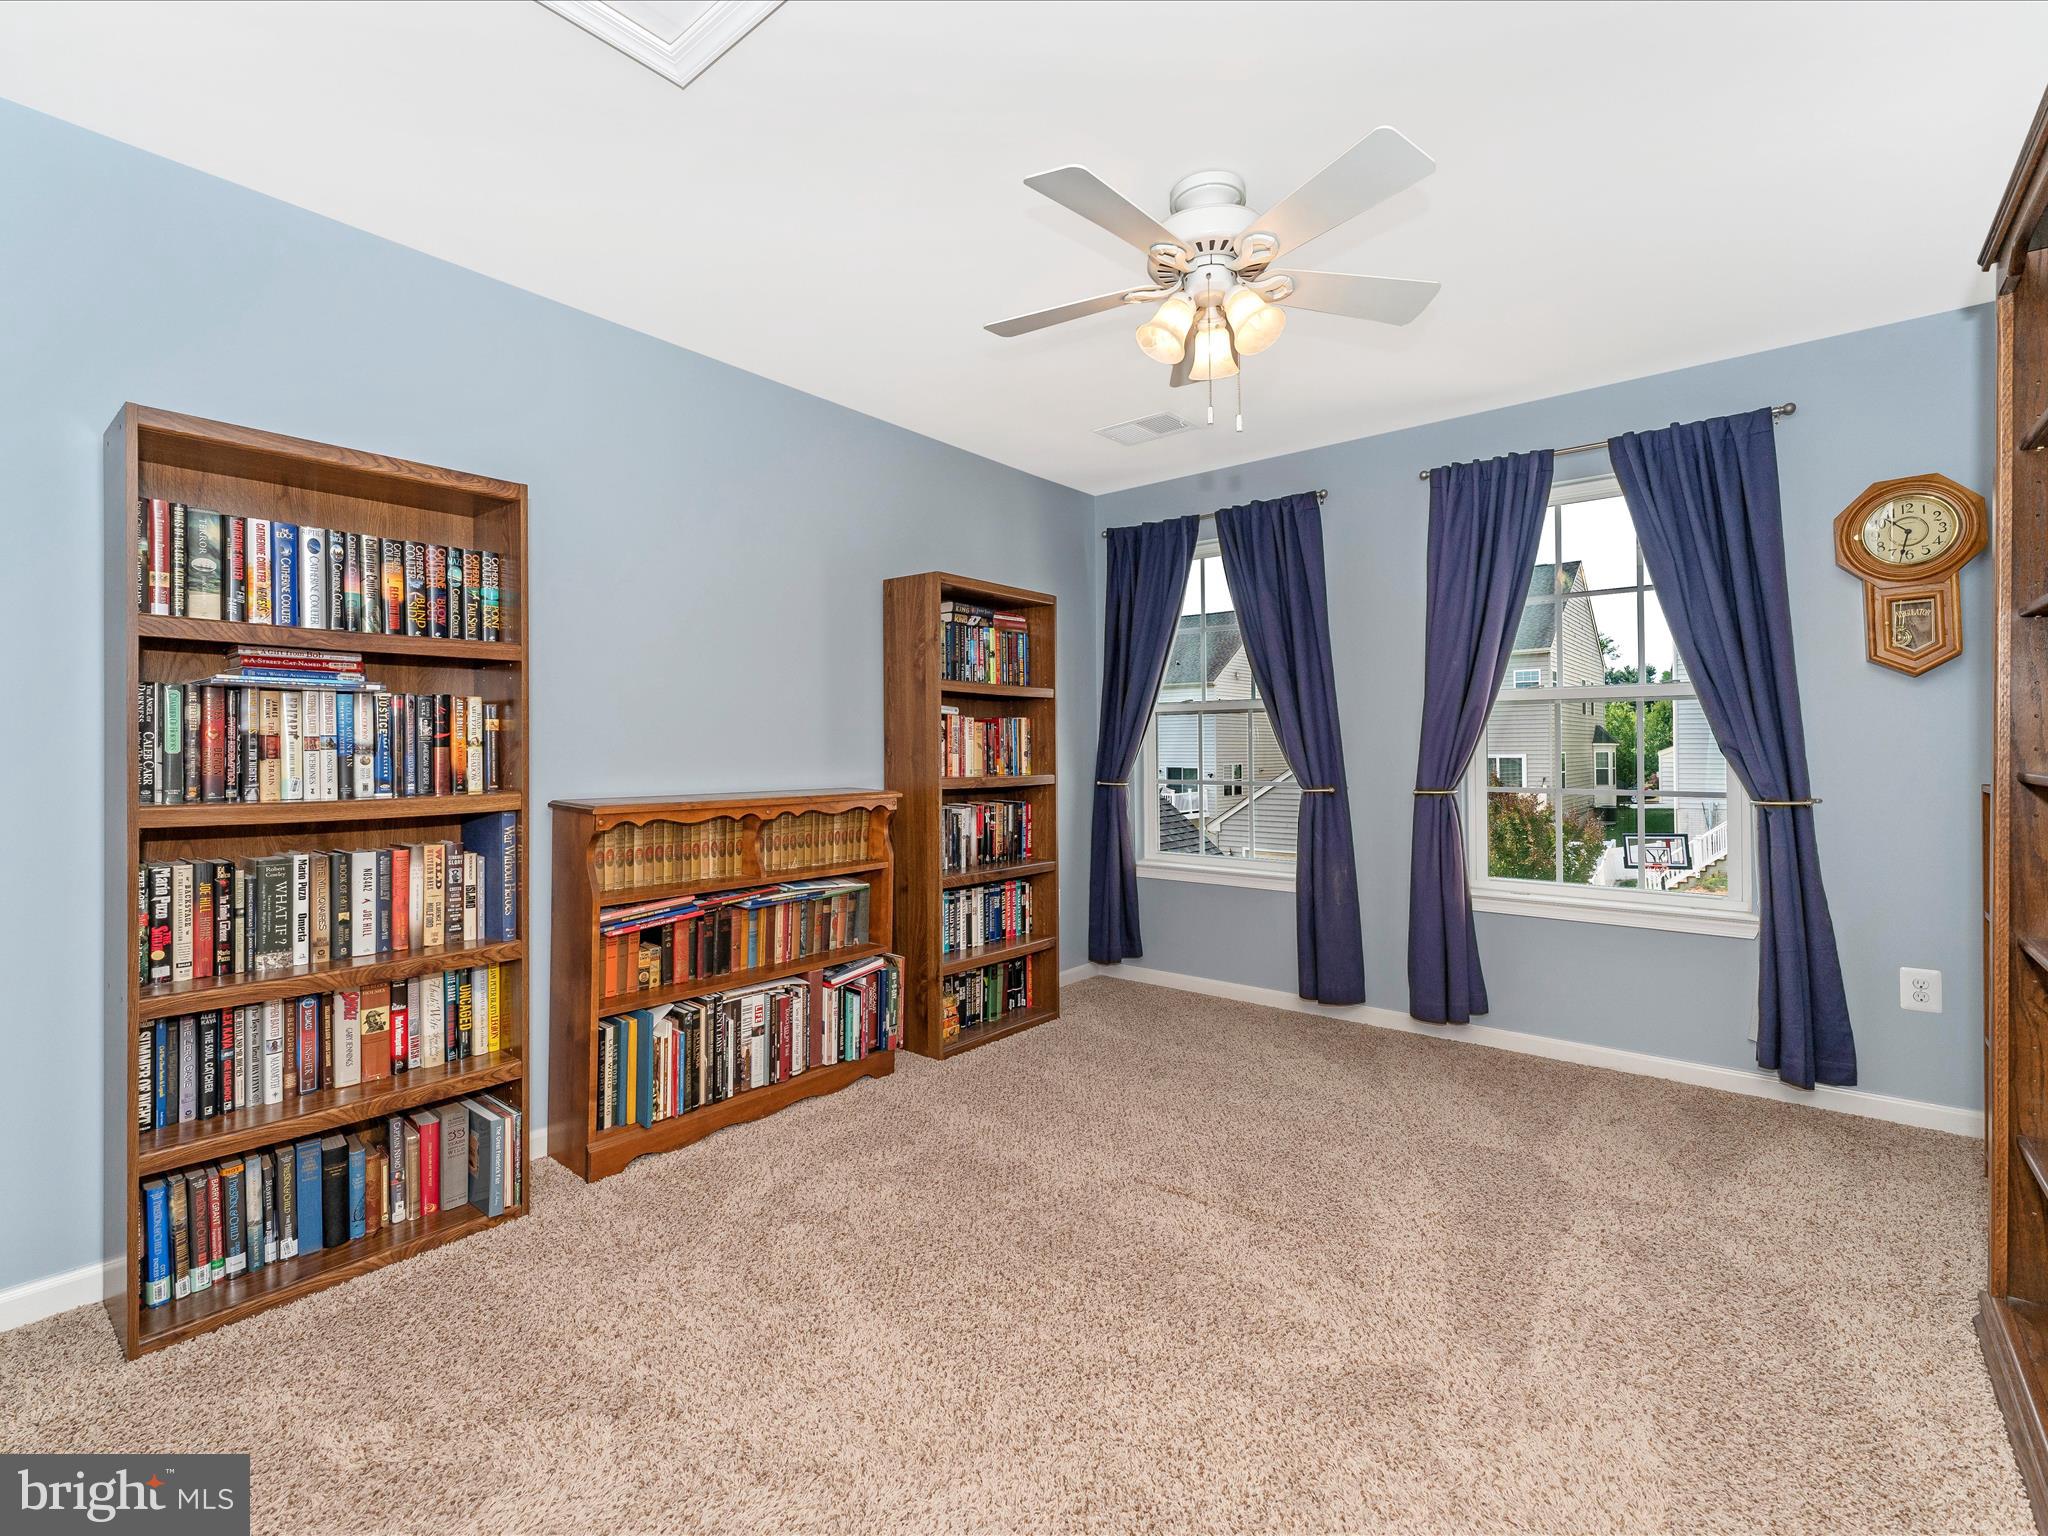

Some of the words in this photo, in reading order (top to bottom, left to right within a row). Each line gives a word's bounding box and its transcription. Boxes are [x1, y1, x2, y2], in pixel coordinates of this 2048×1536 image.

[1901, 503, 1914, 514] 12
[1933, 510, 1942, 521] 2
[199, 519, 207, 553] TERROR
[233, 519, 243, 553] CATHERINE
[256, 523, 265, 555] CATHERINE
[1938, 521, 1947, 533] 3
[348, 536, 356, 564] CATHERINE
[1877, 541, 1885, 552] 8
[1889, 548, 1897, 556] 7
[1921, 544, 1931, 555] 5
[1932, 535, 1943, 545] 4
[233, 554, 243, 580] COULTER
[365, 539, 377, 573] Catherine
[406, 545, 416, 579] COULTER
[416, 546, 424, 580] CATHERINE
[1905, 550, 1914, 560] 6
[257, 557, 266, 582] COULTER
[280, 558, 291, 592] CATHERINE
[310, 556, 319, 592] CATHERINE
[333, 563, 341, 592] CATHERINE
[426, 547, 437, 588] COULTER
[438, 549, 446, 589] CATHERINE
[464, 554, 472, 587] COULTER
[483, 557, 492, 589] COULTER
[366, 574, 378, 600] Coulter
[257, 587, 268, 612] NEMESIS
[282, 594, 291, 623] COULTER
[311, 595, 320, 625] COULTER
[334, 594, 342, 618] COULTER
[409, 602, 417, 622] SIDE
[418, 598, 426, 628] BLIND
[437, 598, 446, 626] BLOW
[452, 615, 460, 636] COULTER
[146, 696, 154, 715] ANGEL
[325, 695, 333, 715] STEPHEN
[379, 696, 388, 734] JUSTICE
[288, 698, 298, 737] EPITAPH
[143, 732, 154, 759] CALEB
[143, 761, 154, 785] CARR
[308, 753, 317, 785] ICEBONES
[504, 825, 514, 844] War
[298, 859, 307, 879] Mario
[317, 861, 326, 876] THE
[436, 848, 444, 890] WILD
[504, 846, 514, 882] Without
[151, 868, 170, 894] Mario
[199, 882, 211, 895] JOE
[298, 882, 307, 901] Puzo
[340, 885, 347, 893] OF
[363, 868, 373, 892] NOS4A2
[151, 896, 170, 919] Puzo
[199, 897, 211, 913] HILL
[275, 881, 287, 922] WHAT
[318, 879, 327, 931] MILLIONAIRES
[504, 884, 515, 916] Heroes
[298, 913, 307, 942] Omerta
[363, 910, 372, 921] JOE
[200, 916, 211, 942] HORNS
[275, 925, 287, 935] IF
[363, 923, 372, 937] HILL
[428, 980, 440, 1008] Ahab's
[430, 1008, 441, 1030] Wife
[459, 984, 471, 1031] UNCAGED
[755, 1005, 763, 1023] LIFE
[184, 1020, 193, 1036] THE
[204, 1030, 214, 1044] THE
[250, 1018, 259, 1032] Boys
[183, 1038, 194, 1062] ZERO
[221, 1028, 233, 1049] KAVA
[411, 1036, 419, 1060] VANISH
[139, 1031, 151, 1077] SUMMER
[204, 1045, 214, 1061] SOUL
[183, 1065, 194, 1088] GAME
[202, 1062, 215, 1093] CATCHER
[271, 1057, 279, 1088] MAMMOTH
[139, 1079, 151, 1091] OF
[139, 1092, 151, 1123] NIGHT
[394, 1150, 402, 1169] NEMO
[495, 1150, 503, 1173] Frederick
[283, 1163, 291, 1186] PRESTON
[211, 1178, 219, 1200] BARRY
[230, 1179, 239, 1208] PRESTON
[283, 1195, 291, 1213] CHILD
[230, 1218, 240, 1240] CHILD
